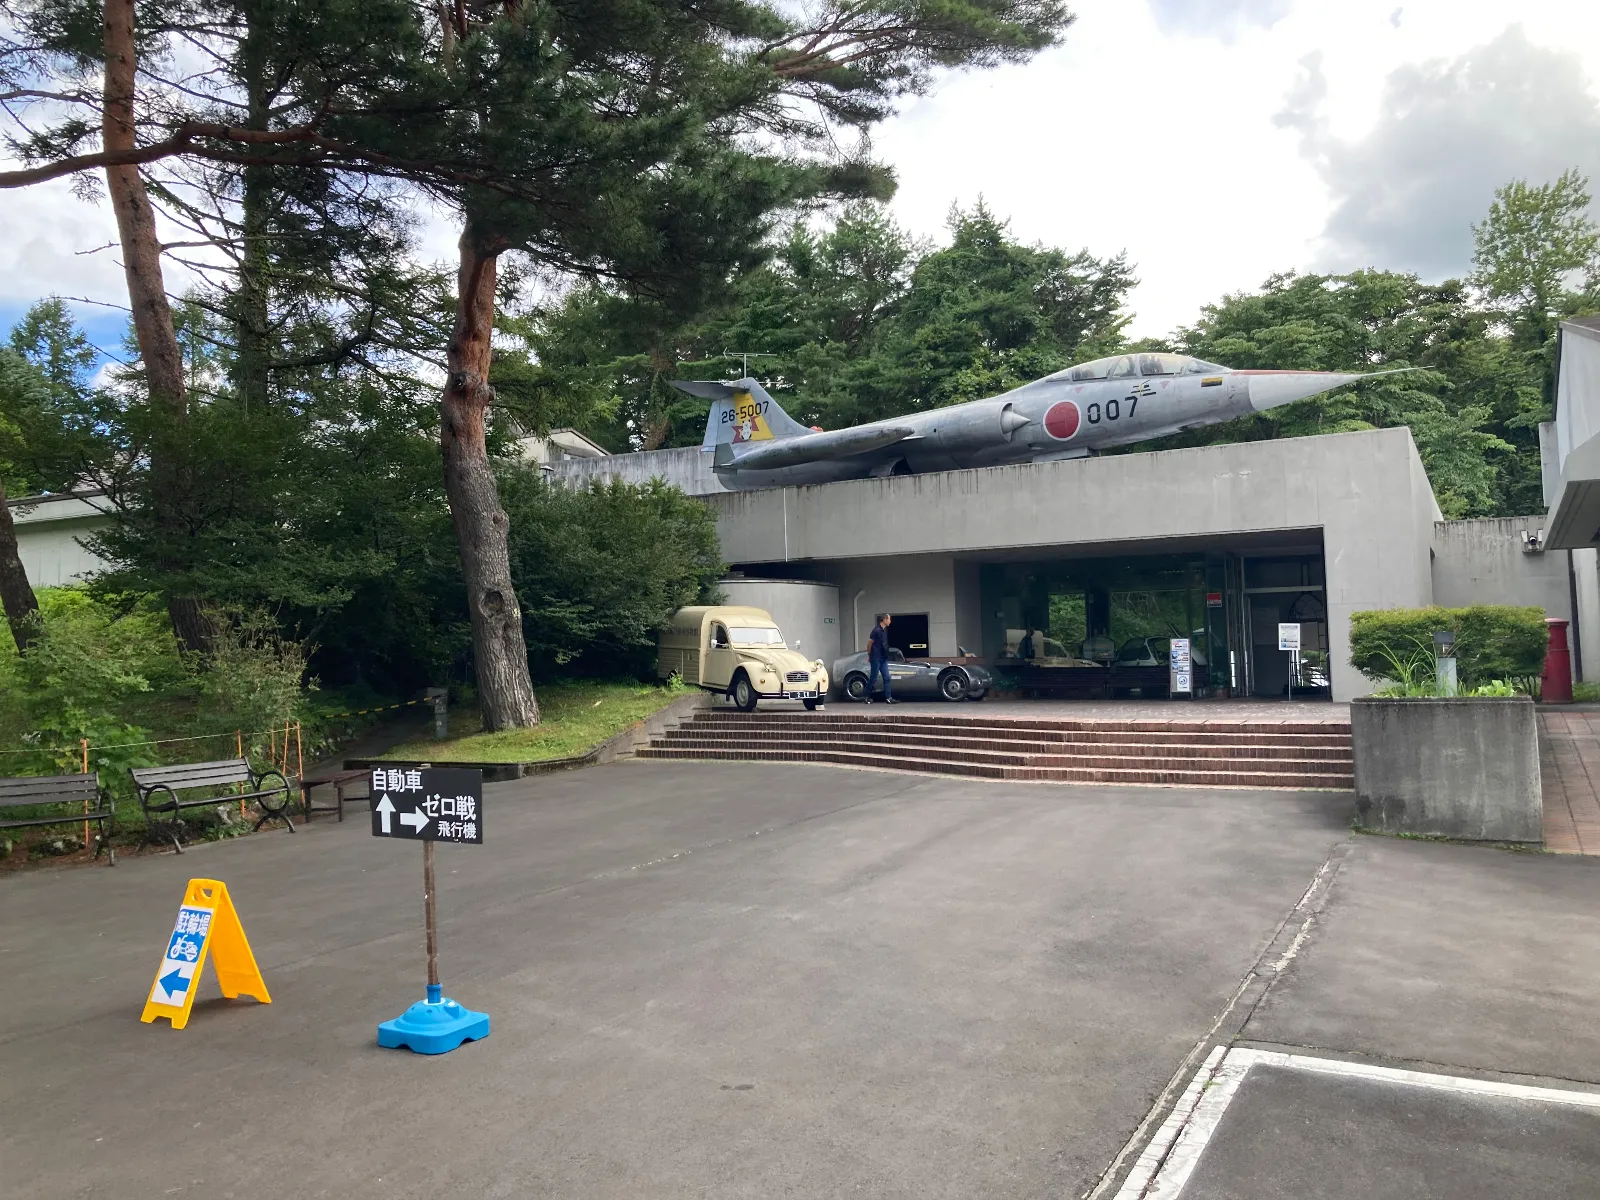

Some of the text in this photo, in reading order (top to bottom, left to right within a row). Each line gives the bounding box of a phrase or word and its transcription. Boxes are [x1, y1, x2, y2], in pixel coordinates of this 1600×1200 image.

[721, 401, 769, 424] 26-5007
[1087, 396, 1139, 424] 007
[373, 768, 423, 793] 自動車
[422, 793, 476, 821] ゼロ戦
[438, 821, 477, 839] 飛行機
[176, 912, 211, 937] 駐輪場
